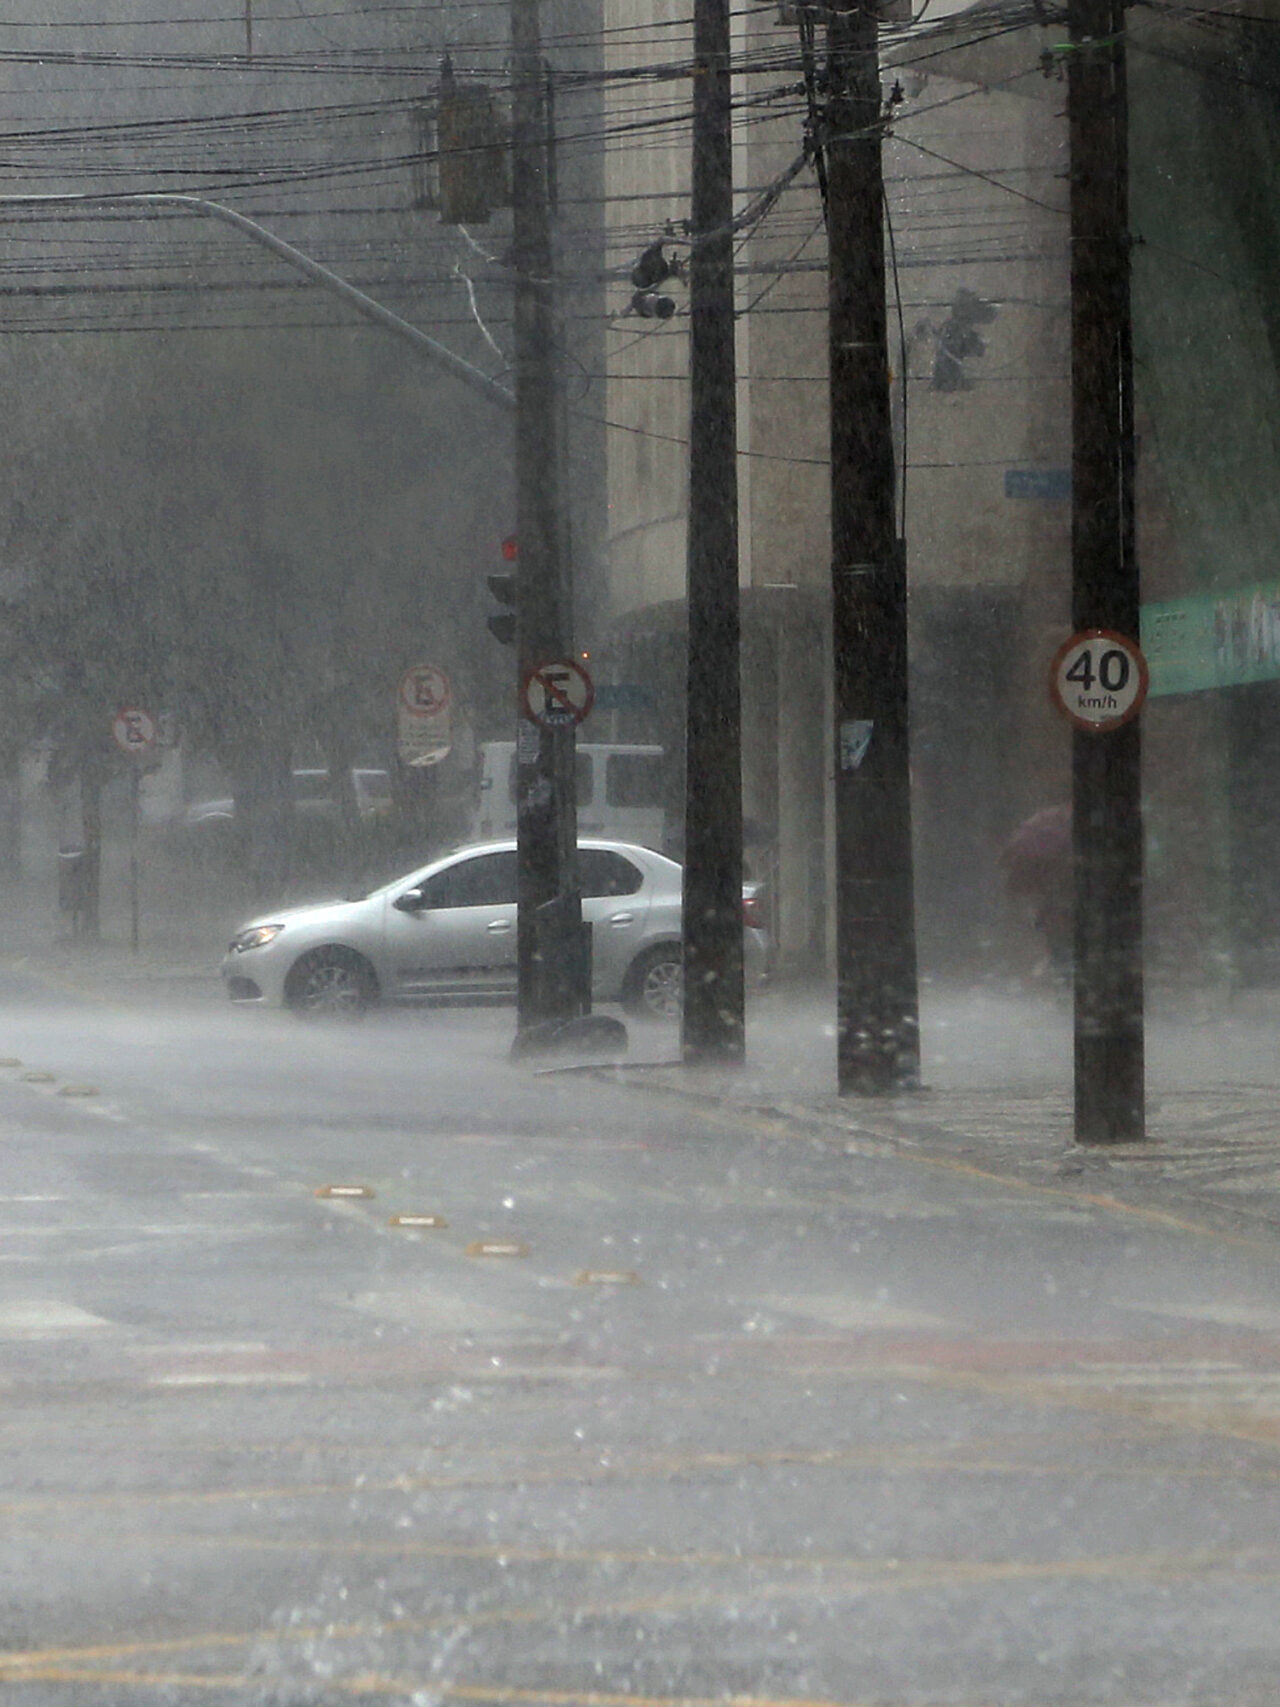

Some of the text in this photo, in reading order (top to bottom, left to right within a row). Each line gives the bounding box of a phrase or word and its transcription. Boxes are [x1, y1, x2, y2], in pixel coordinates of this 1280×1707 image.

[1066, 649, 1129, 691] 40
[544, 672, 572, 714] E
[1078, 694, 1117, 708] km/h
